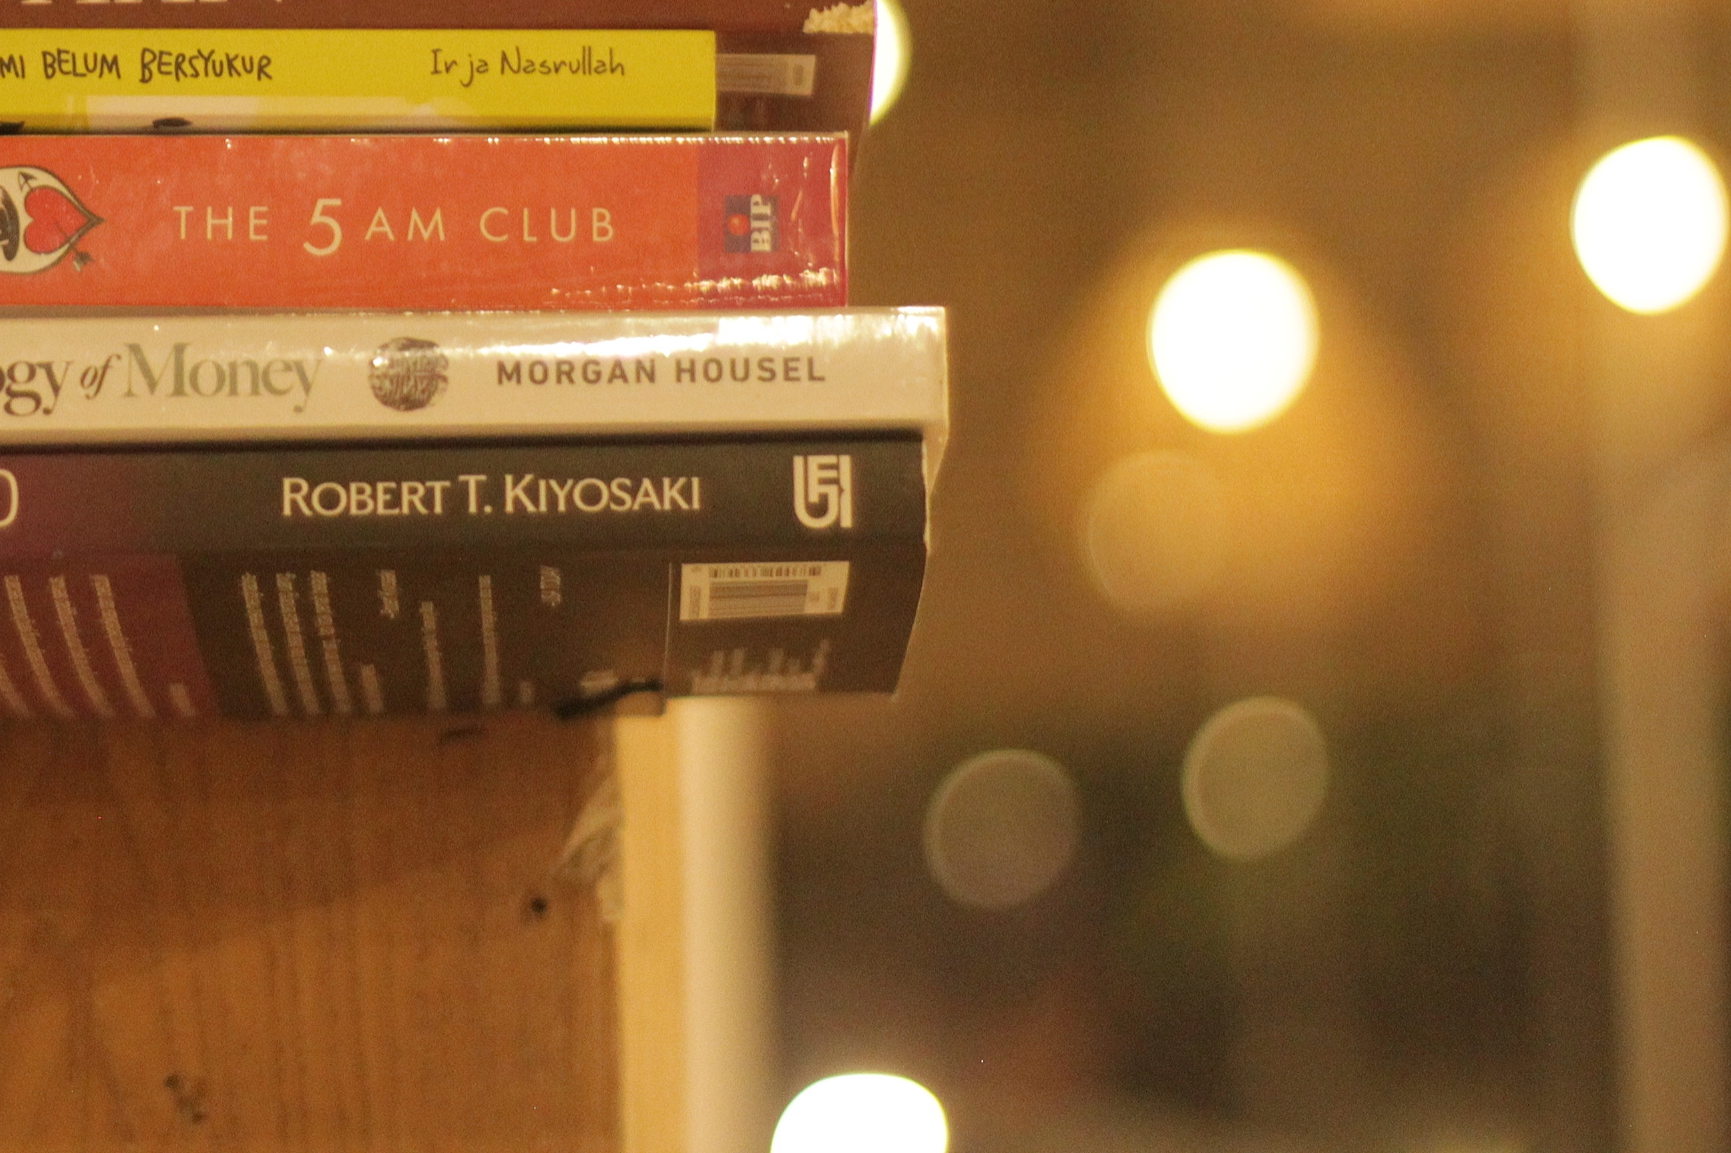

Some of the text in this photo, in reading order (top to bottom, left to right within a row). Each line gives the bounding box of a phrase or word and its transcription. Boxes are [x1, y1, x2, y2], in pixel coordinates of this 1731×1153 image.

[43, 49, 120, 80] BELUM
[139, 50, 273, 83] BERSYUKUR
[500, 49, 626, 78] Nasrullah
[173, 198, 616, 256] THE 5 AM CLUB
[80, 353, 123, 399] of
[125, 342, 322, 413] Money
[496, 356, 826, 386] MORGAN HOUSEL
[282, 474, 701, 516] ROBERT T. KIYOSAKI
